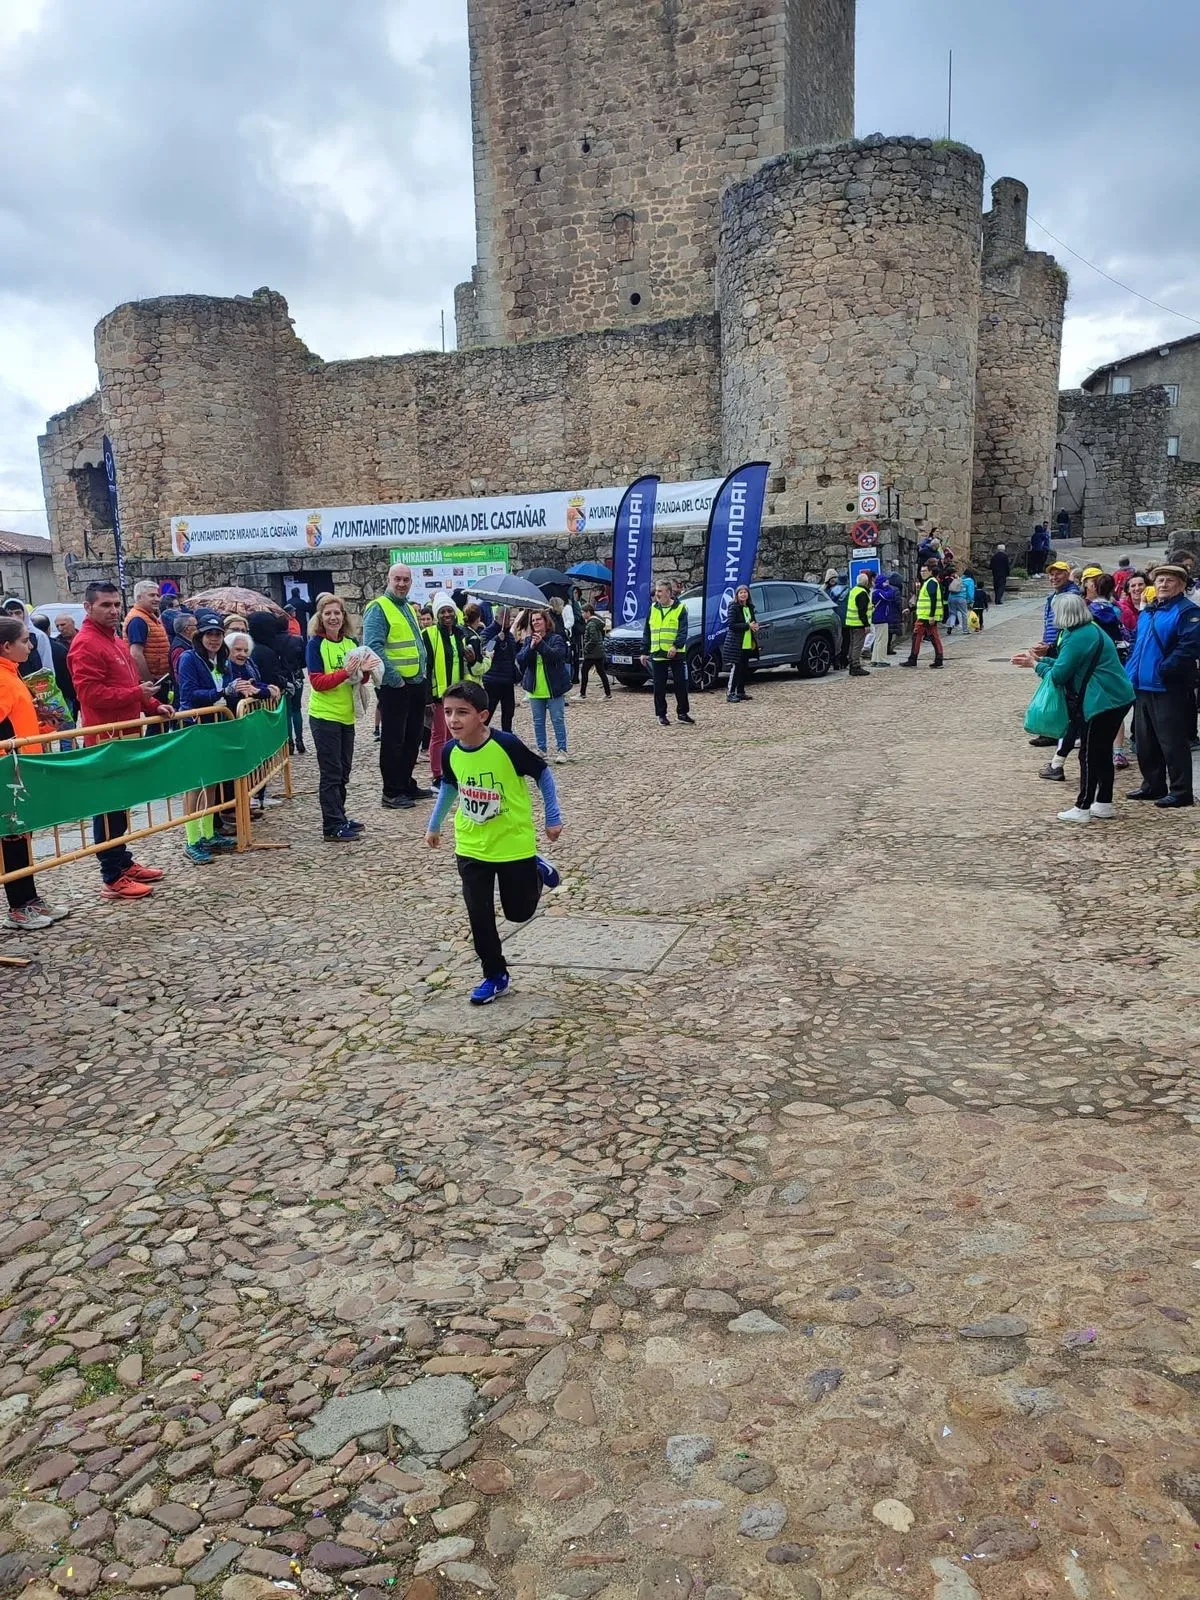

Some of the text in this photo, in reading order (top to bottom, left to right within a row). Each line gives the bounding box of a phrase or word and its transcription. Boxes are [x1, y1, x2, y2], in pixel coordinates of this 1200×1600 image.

[656, 500, 681, 514] RANDA
[682, 499, 694, 512] DEL
[694, 497, 713, 511] CAST
[191, 522, 298, 543] AYUNTAMIENTO DE MIRANDA DEL CASTAÑAR
[332, 505, 547, 539] AYUNTAMIENTO DE MIRANDA DEL CASTAÑAR
[725, 482, 748, 582] HYUNDAI
[627, 493, 643, 586] HYUNDAI
[393, 549, 443, 563] LA MIRANDEÑA
[463, 797, 489, 816] 307
